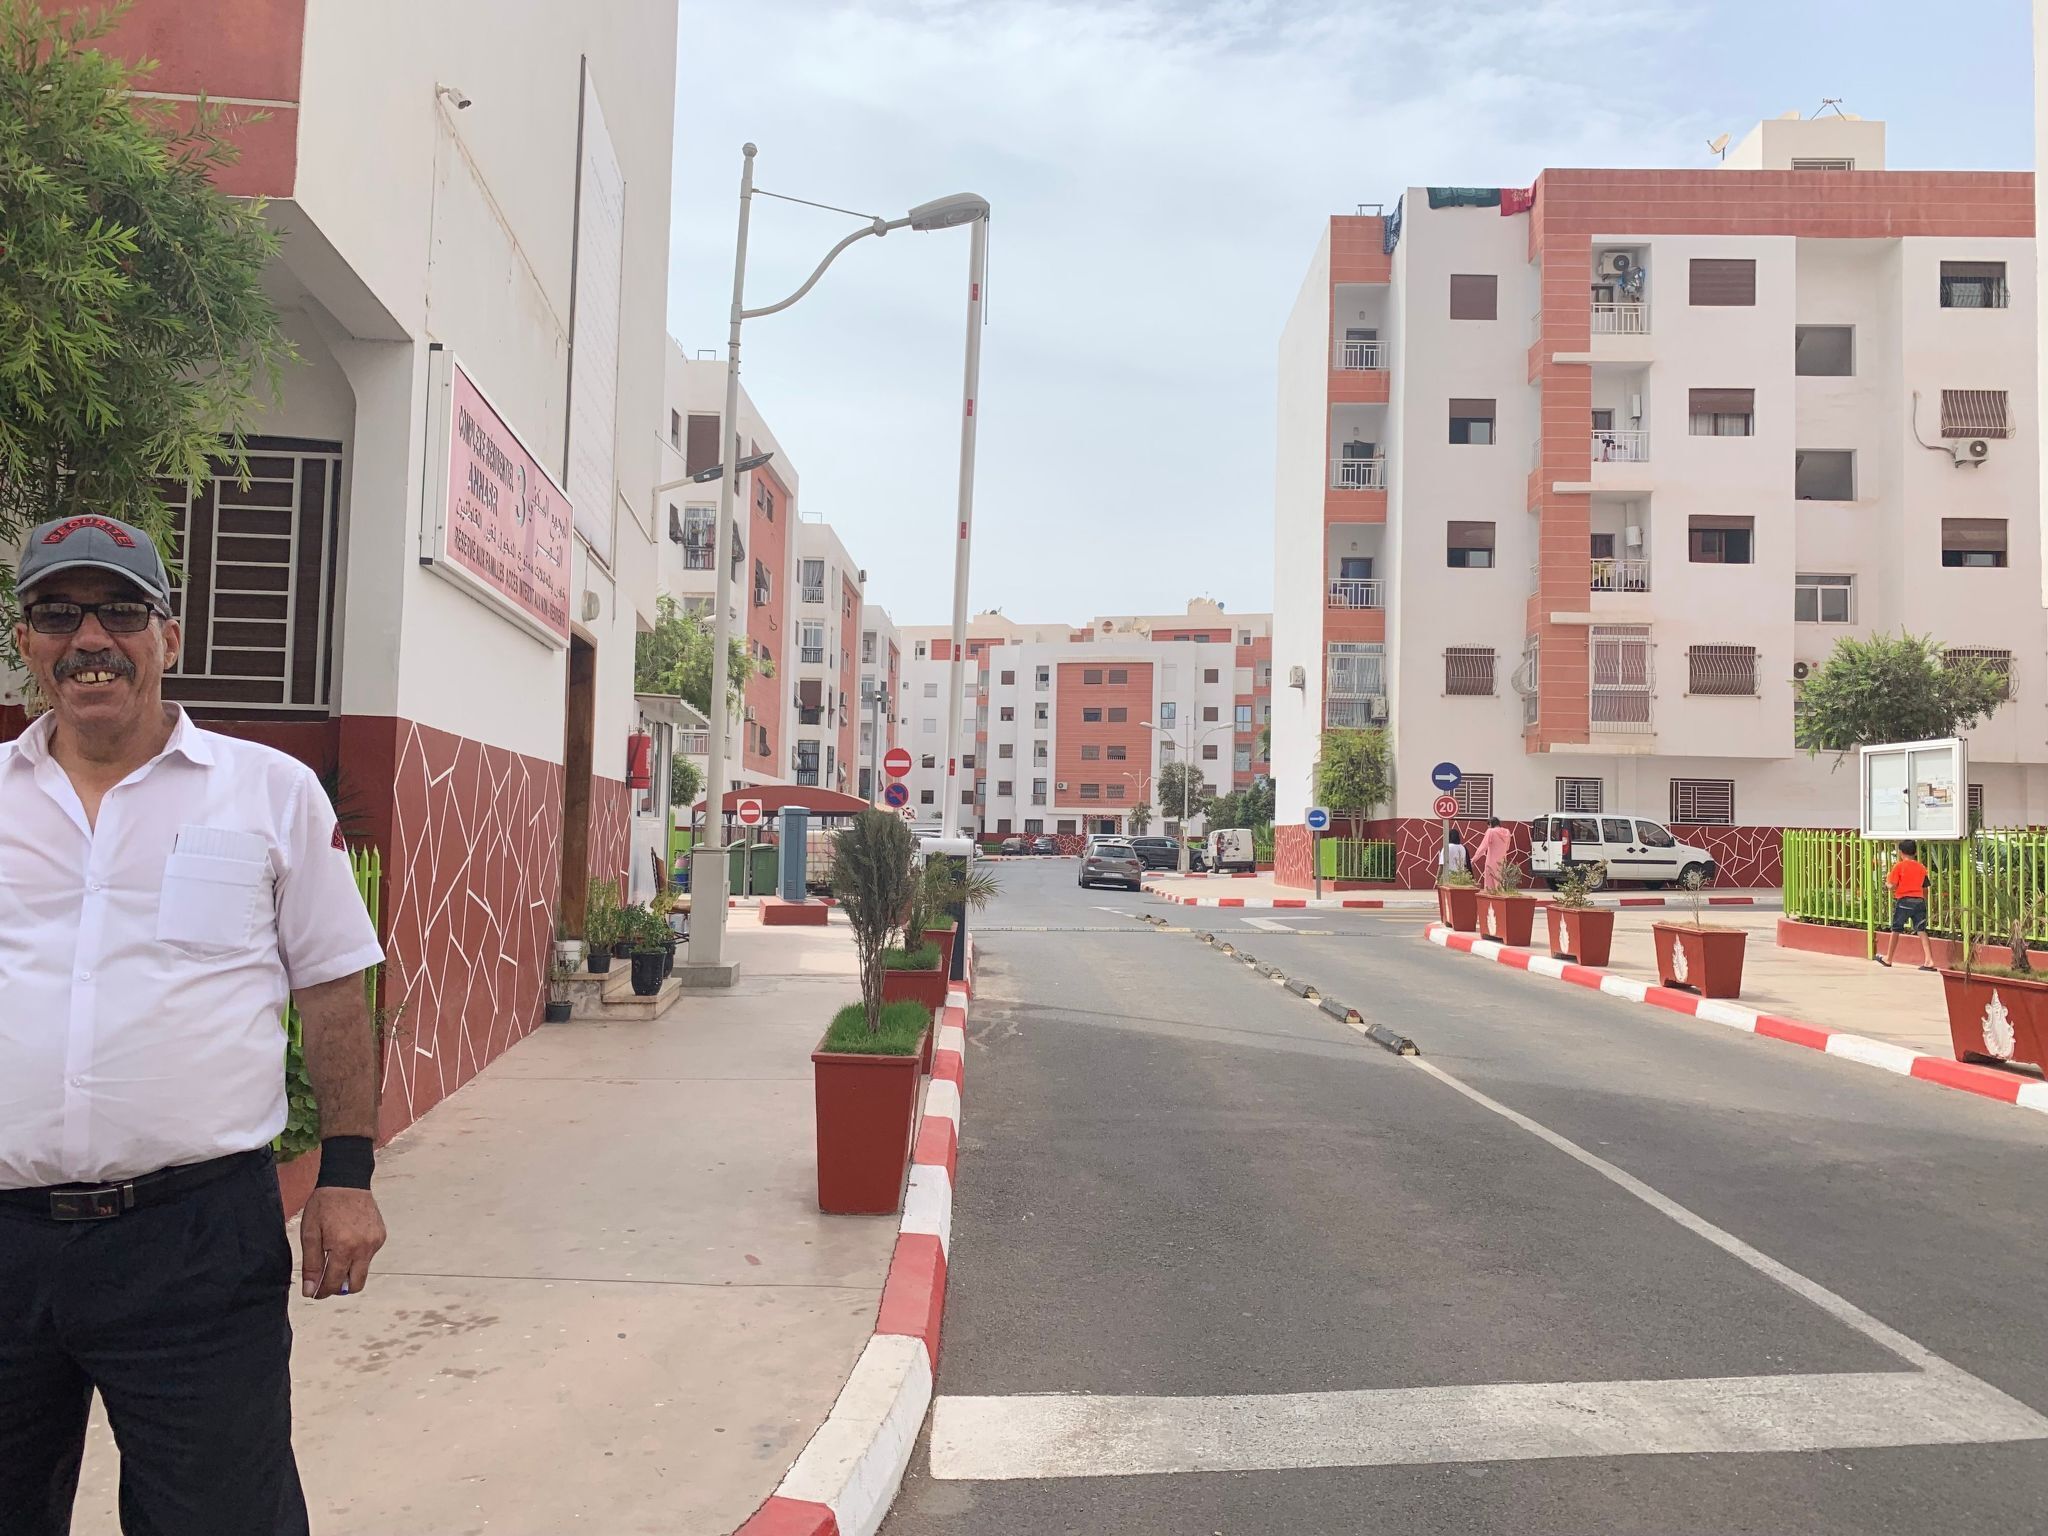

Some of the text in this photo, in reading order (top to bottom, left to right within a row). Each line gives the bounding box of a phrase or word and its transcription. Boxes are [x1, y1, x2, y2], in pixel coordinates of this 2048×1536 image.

[458, 405, 486, 462] COMPLEXE
[468, 461, 498, 517] ANNASR
[515, 464, 527, 528] 3
[49, 517, 131, 546] SECURITE
[1439, 801, 1454, 813] 20
